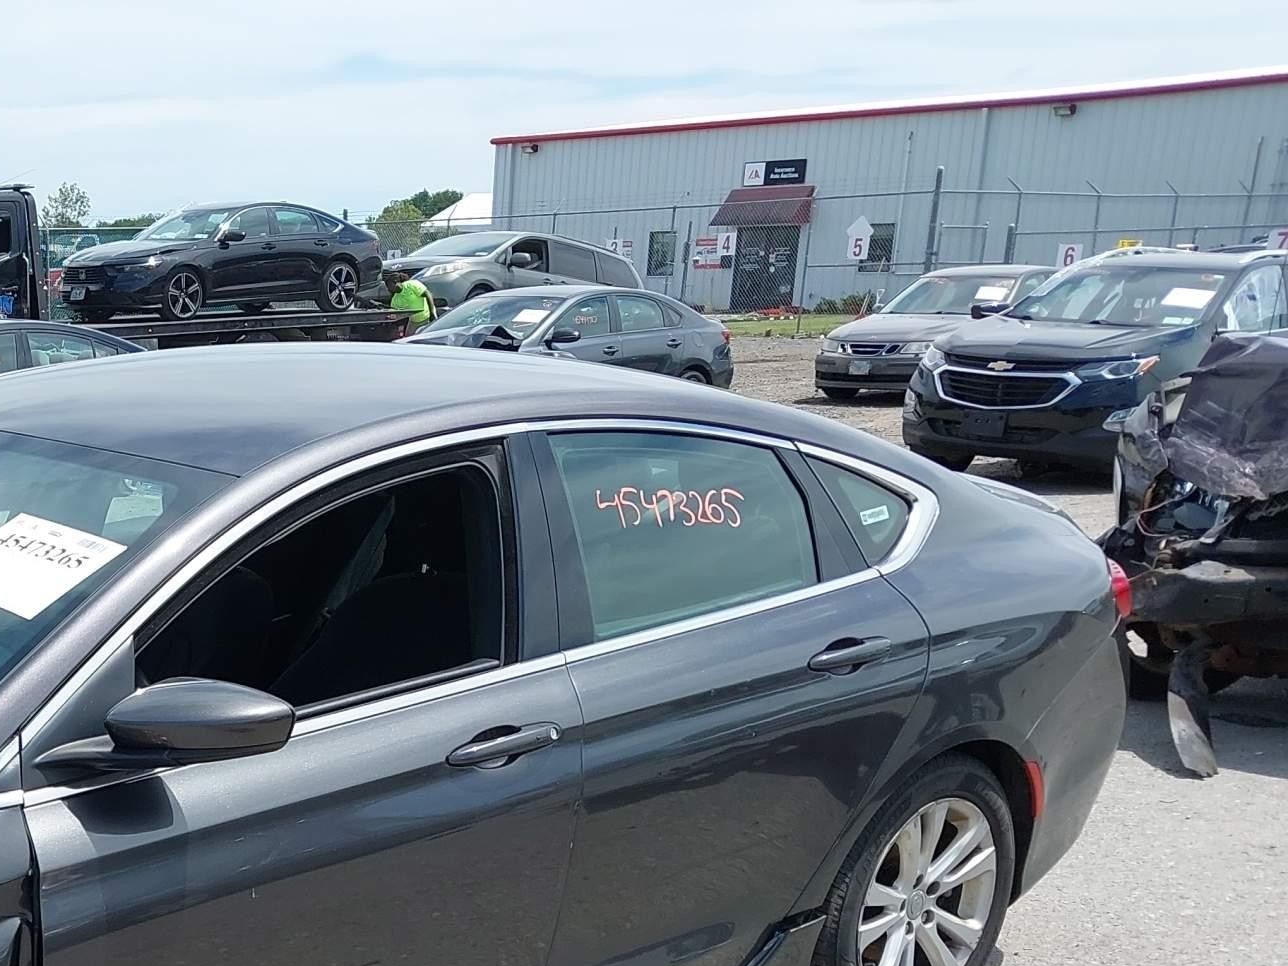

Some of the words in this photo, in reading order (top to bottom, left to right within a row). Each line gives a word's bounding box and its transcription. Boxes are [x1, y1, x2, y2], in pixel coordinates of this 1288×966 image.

[722, 234, 731, 253] 4
[852, 237, 863, 257] 5
[1063, 246, 1075, 267] 6
[596, 487, 745, 528] 45473265
